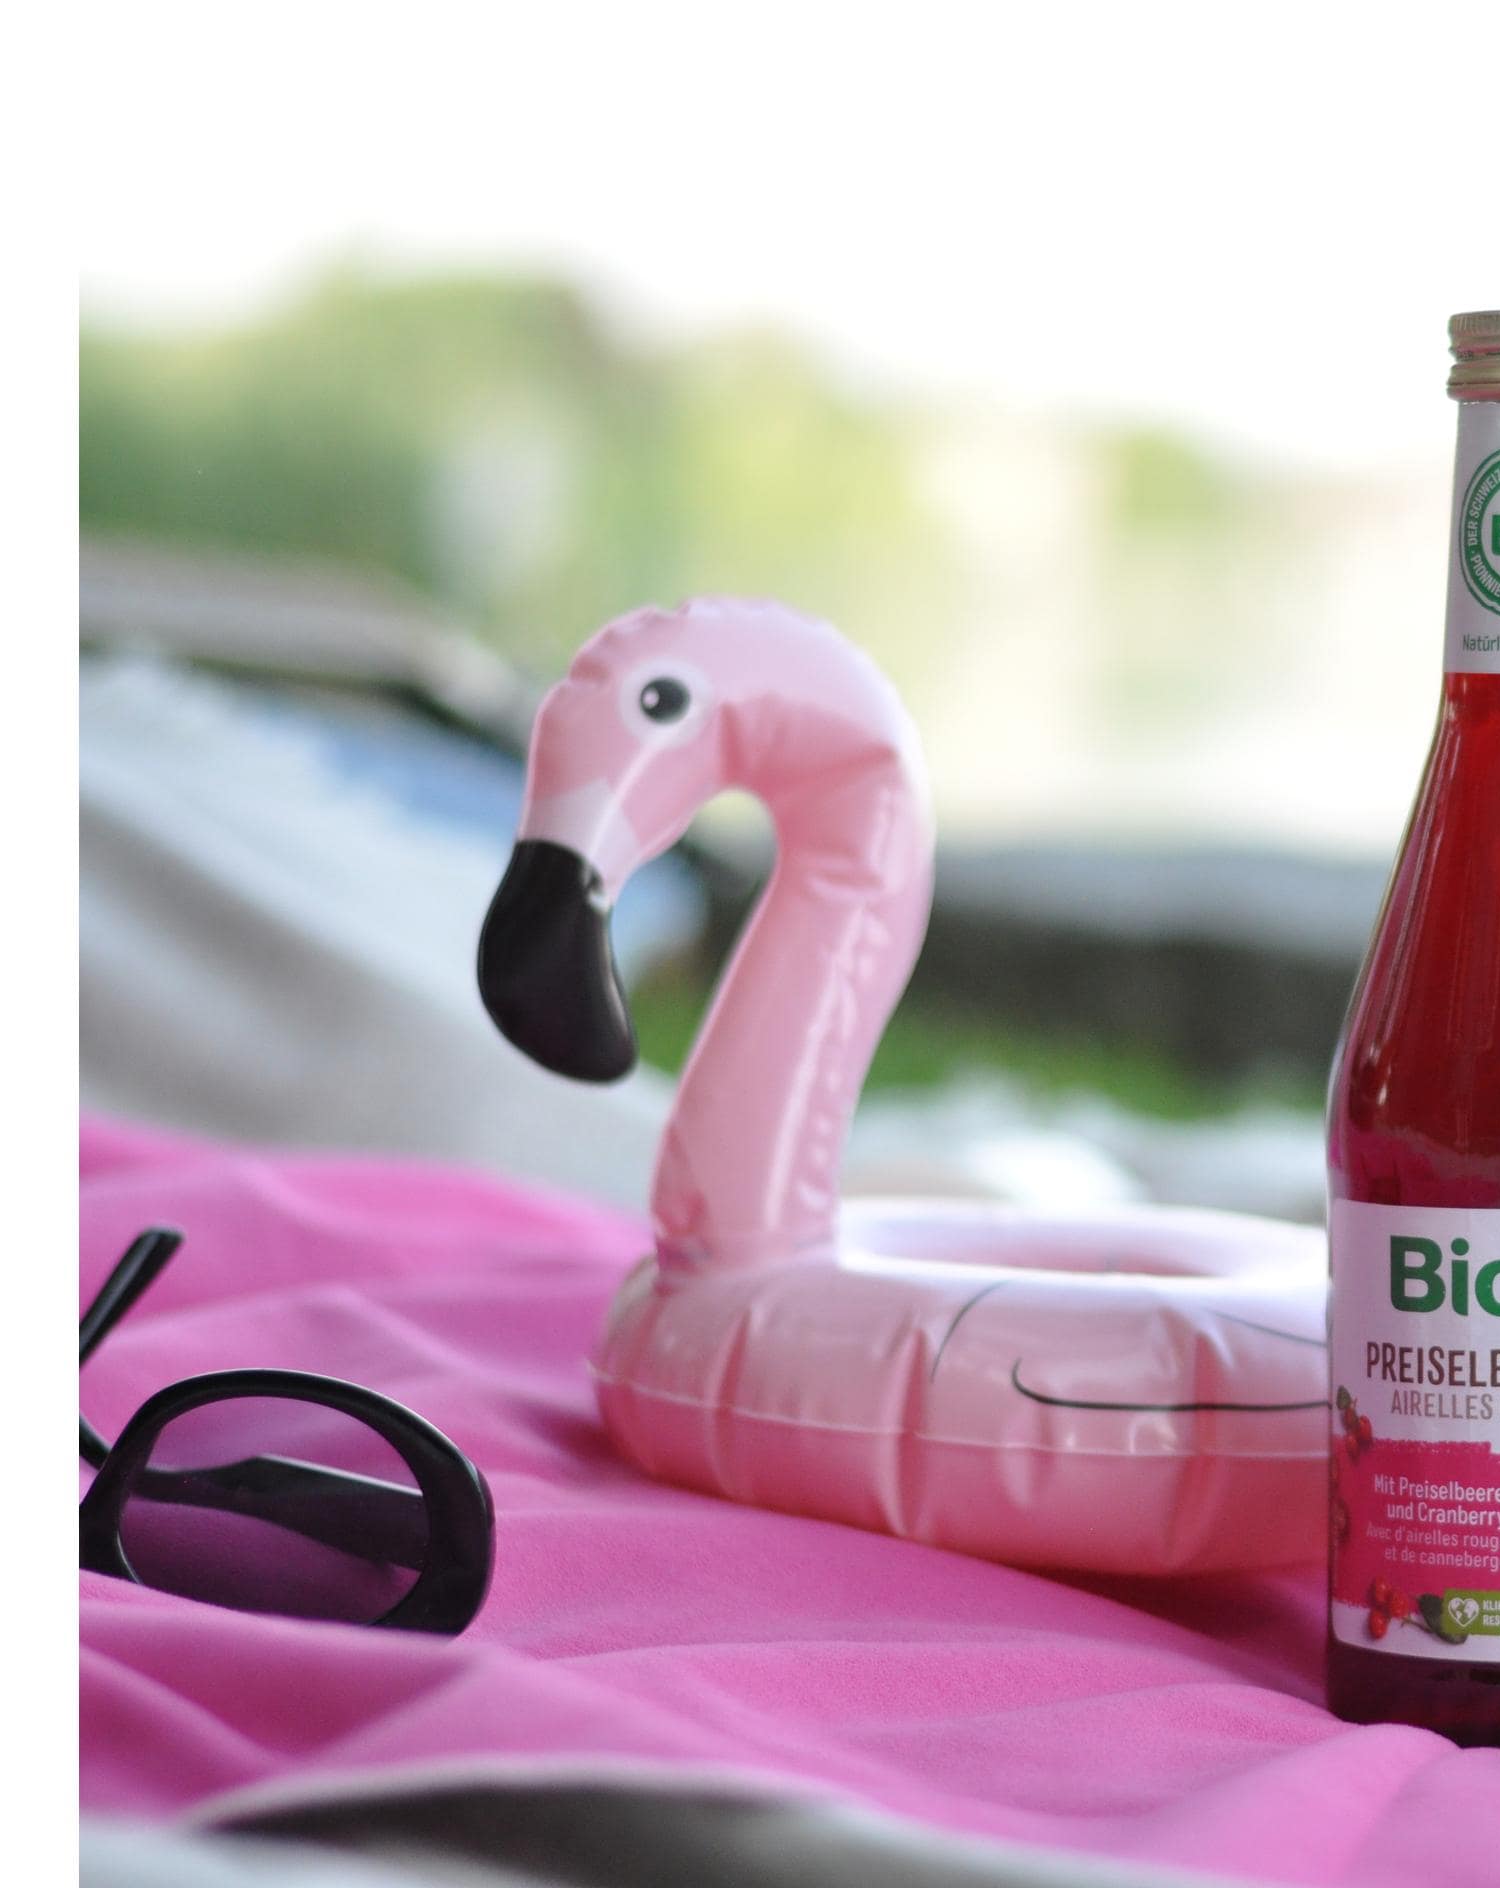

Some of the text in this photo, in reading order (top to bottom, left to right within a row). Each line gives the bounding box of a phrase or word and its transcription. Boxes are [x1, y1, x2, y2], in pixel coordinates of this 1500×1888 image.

[1468, 520, 1478, 547] DER
[1391, 1389, 1494, 1420] AIRELLES
[1374, 1473, 1395, 1496] Mit
[1387, 1501, 1413, 1520] und
[1366, 1522, 1391, 1539] Avec
[1395, 1526, 1459, 1546] d'airelles
[1384, 1546, 1397, 1561] et
[1401, 1547, 1416, 1563] de
